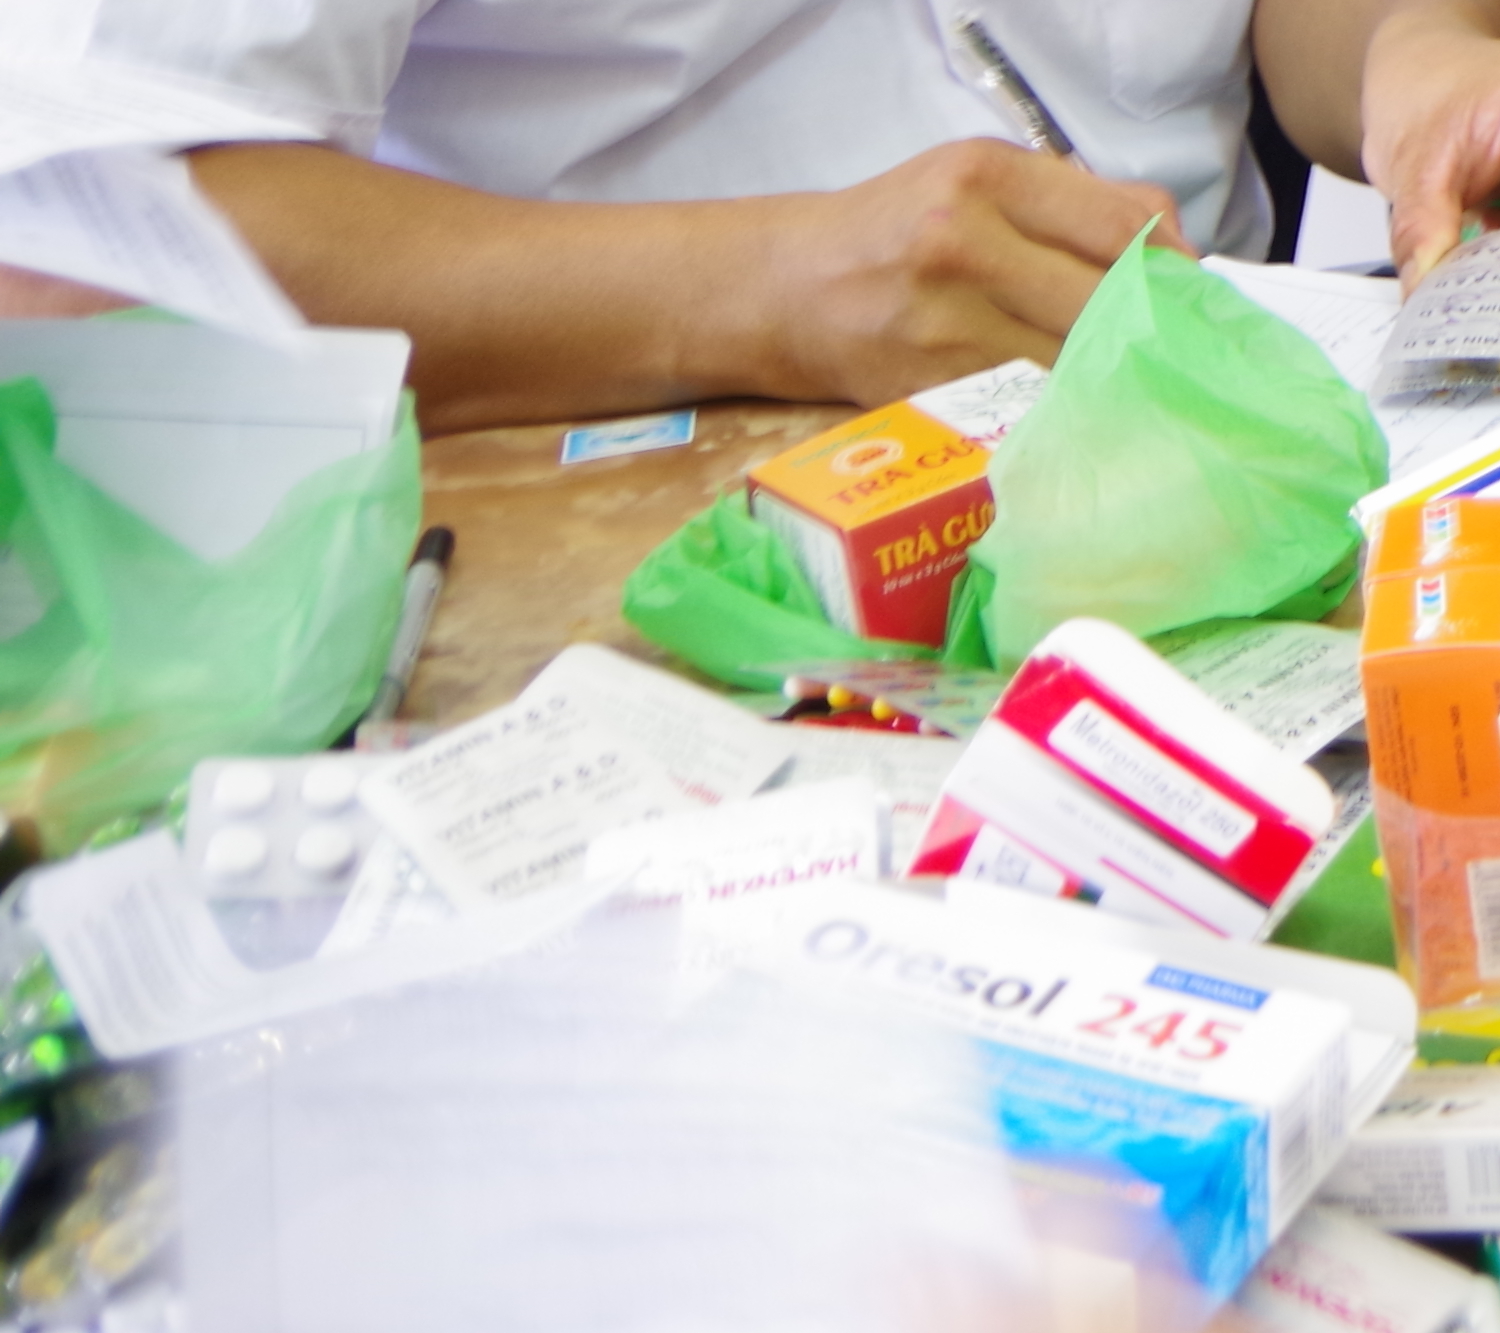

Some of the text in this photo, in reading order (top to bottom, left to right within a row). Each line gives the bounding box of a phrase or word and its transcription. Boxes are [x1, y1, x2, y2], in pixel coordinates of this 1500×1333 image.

[1070, 710, 1204, 821] Metronidazol
[802, 918, 1071, 1020] Oresol
[1077, 993, 1245, 1064] 245
